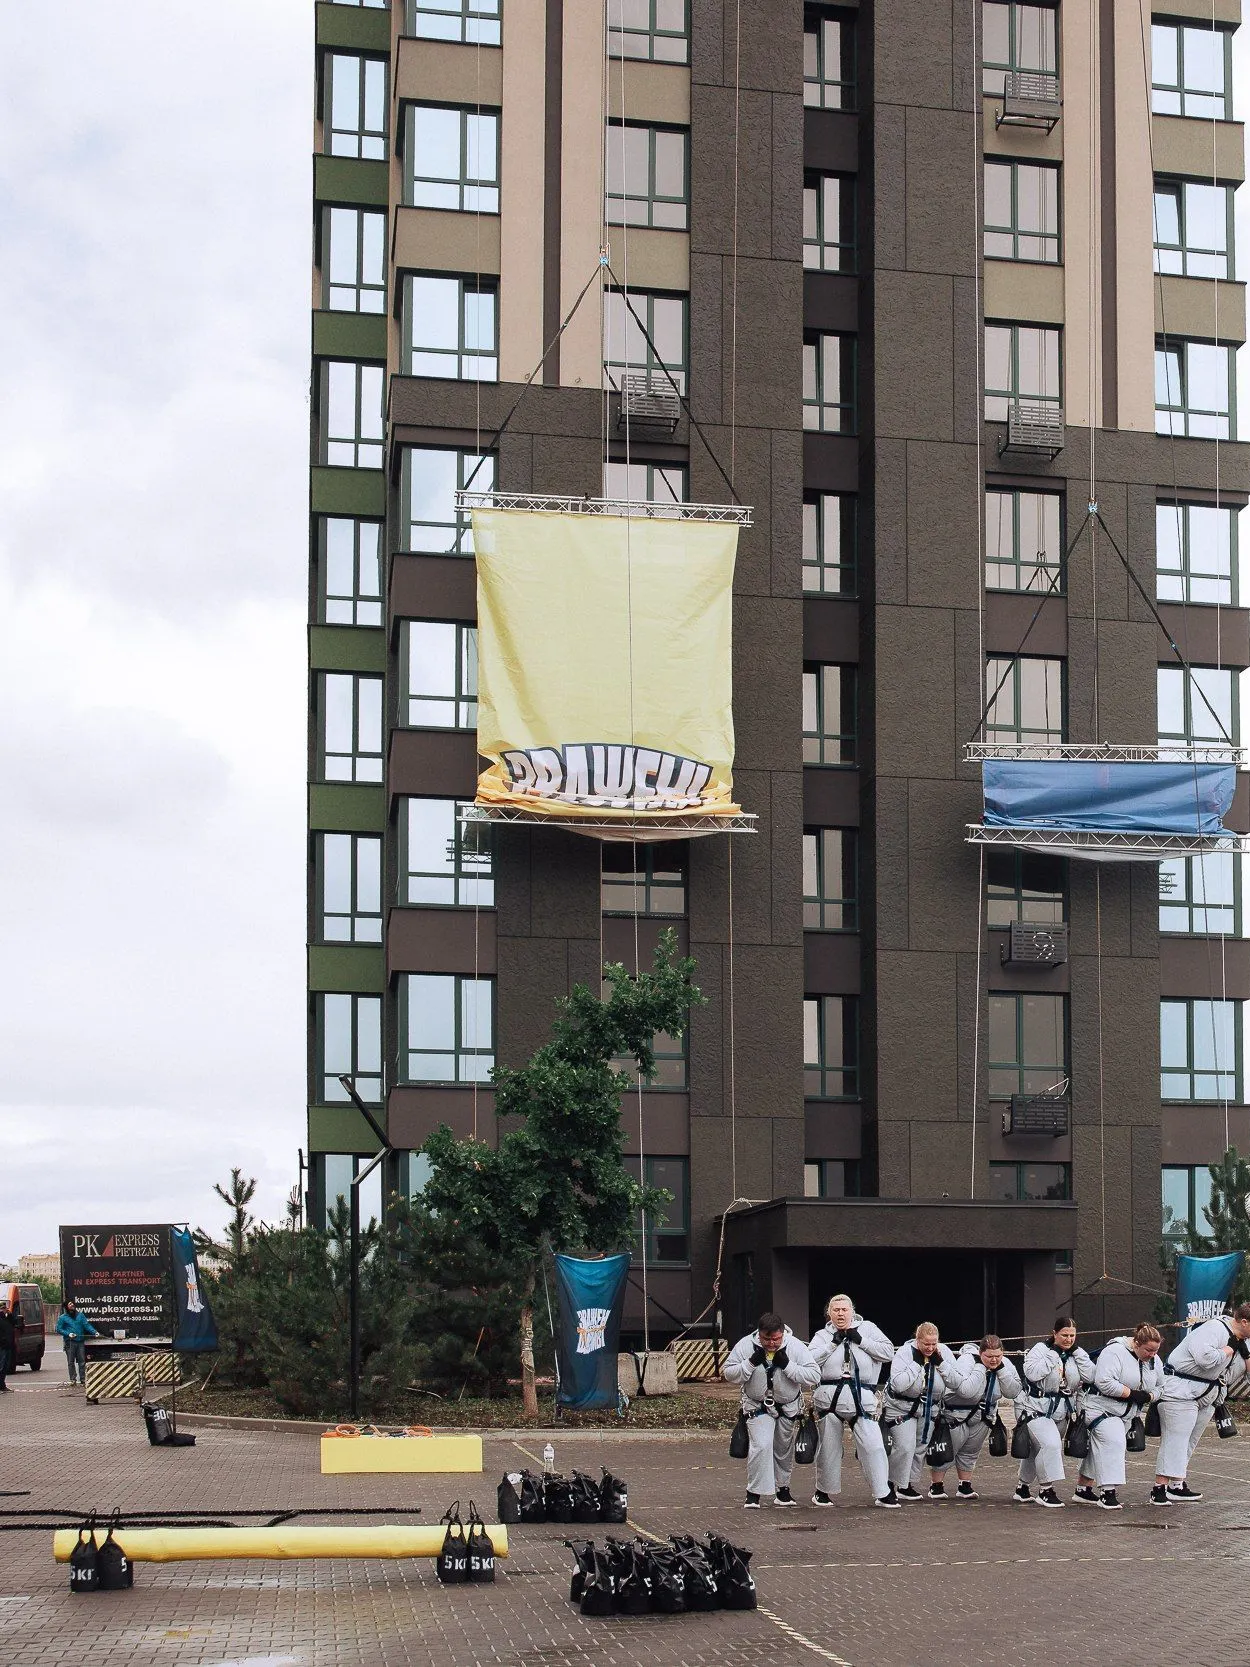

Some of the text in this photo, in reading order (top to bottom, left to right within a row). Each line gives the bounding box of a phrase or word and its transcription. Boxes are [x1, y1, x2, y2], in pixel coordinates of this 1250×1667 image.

[73, 1234, 160, 1258] PK EXPRESS
[115, 1247, 160, 1257] PIETRZAK
[90, 1271, 110, 1279] YOUR
[74, 1278, 83, 1286] IN
[119, 1277, 161, 1285] TRANSPORT
[75, 1296, 95, 1304] kom.
[96, 1295, 112, 1303] +48
[113, 1295, 129, 1303] 607
[130, 1295, 146, 1303] 782
[75, 1304, 163, 1315] www.pkexpress.pl
[153, 1409, 167, 1421] 30
[620, 1494, 627, 1508] 5
[121, 1557, 128, 1572] 5
[445, 1555, 453, 1569] 5
[471, 1556, 480, 1570] 5
